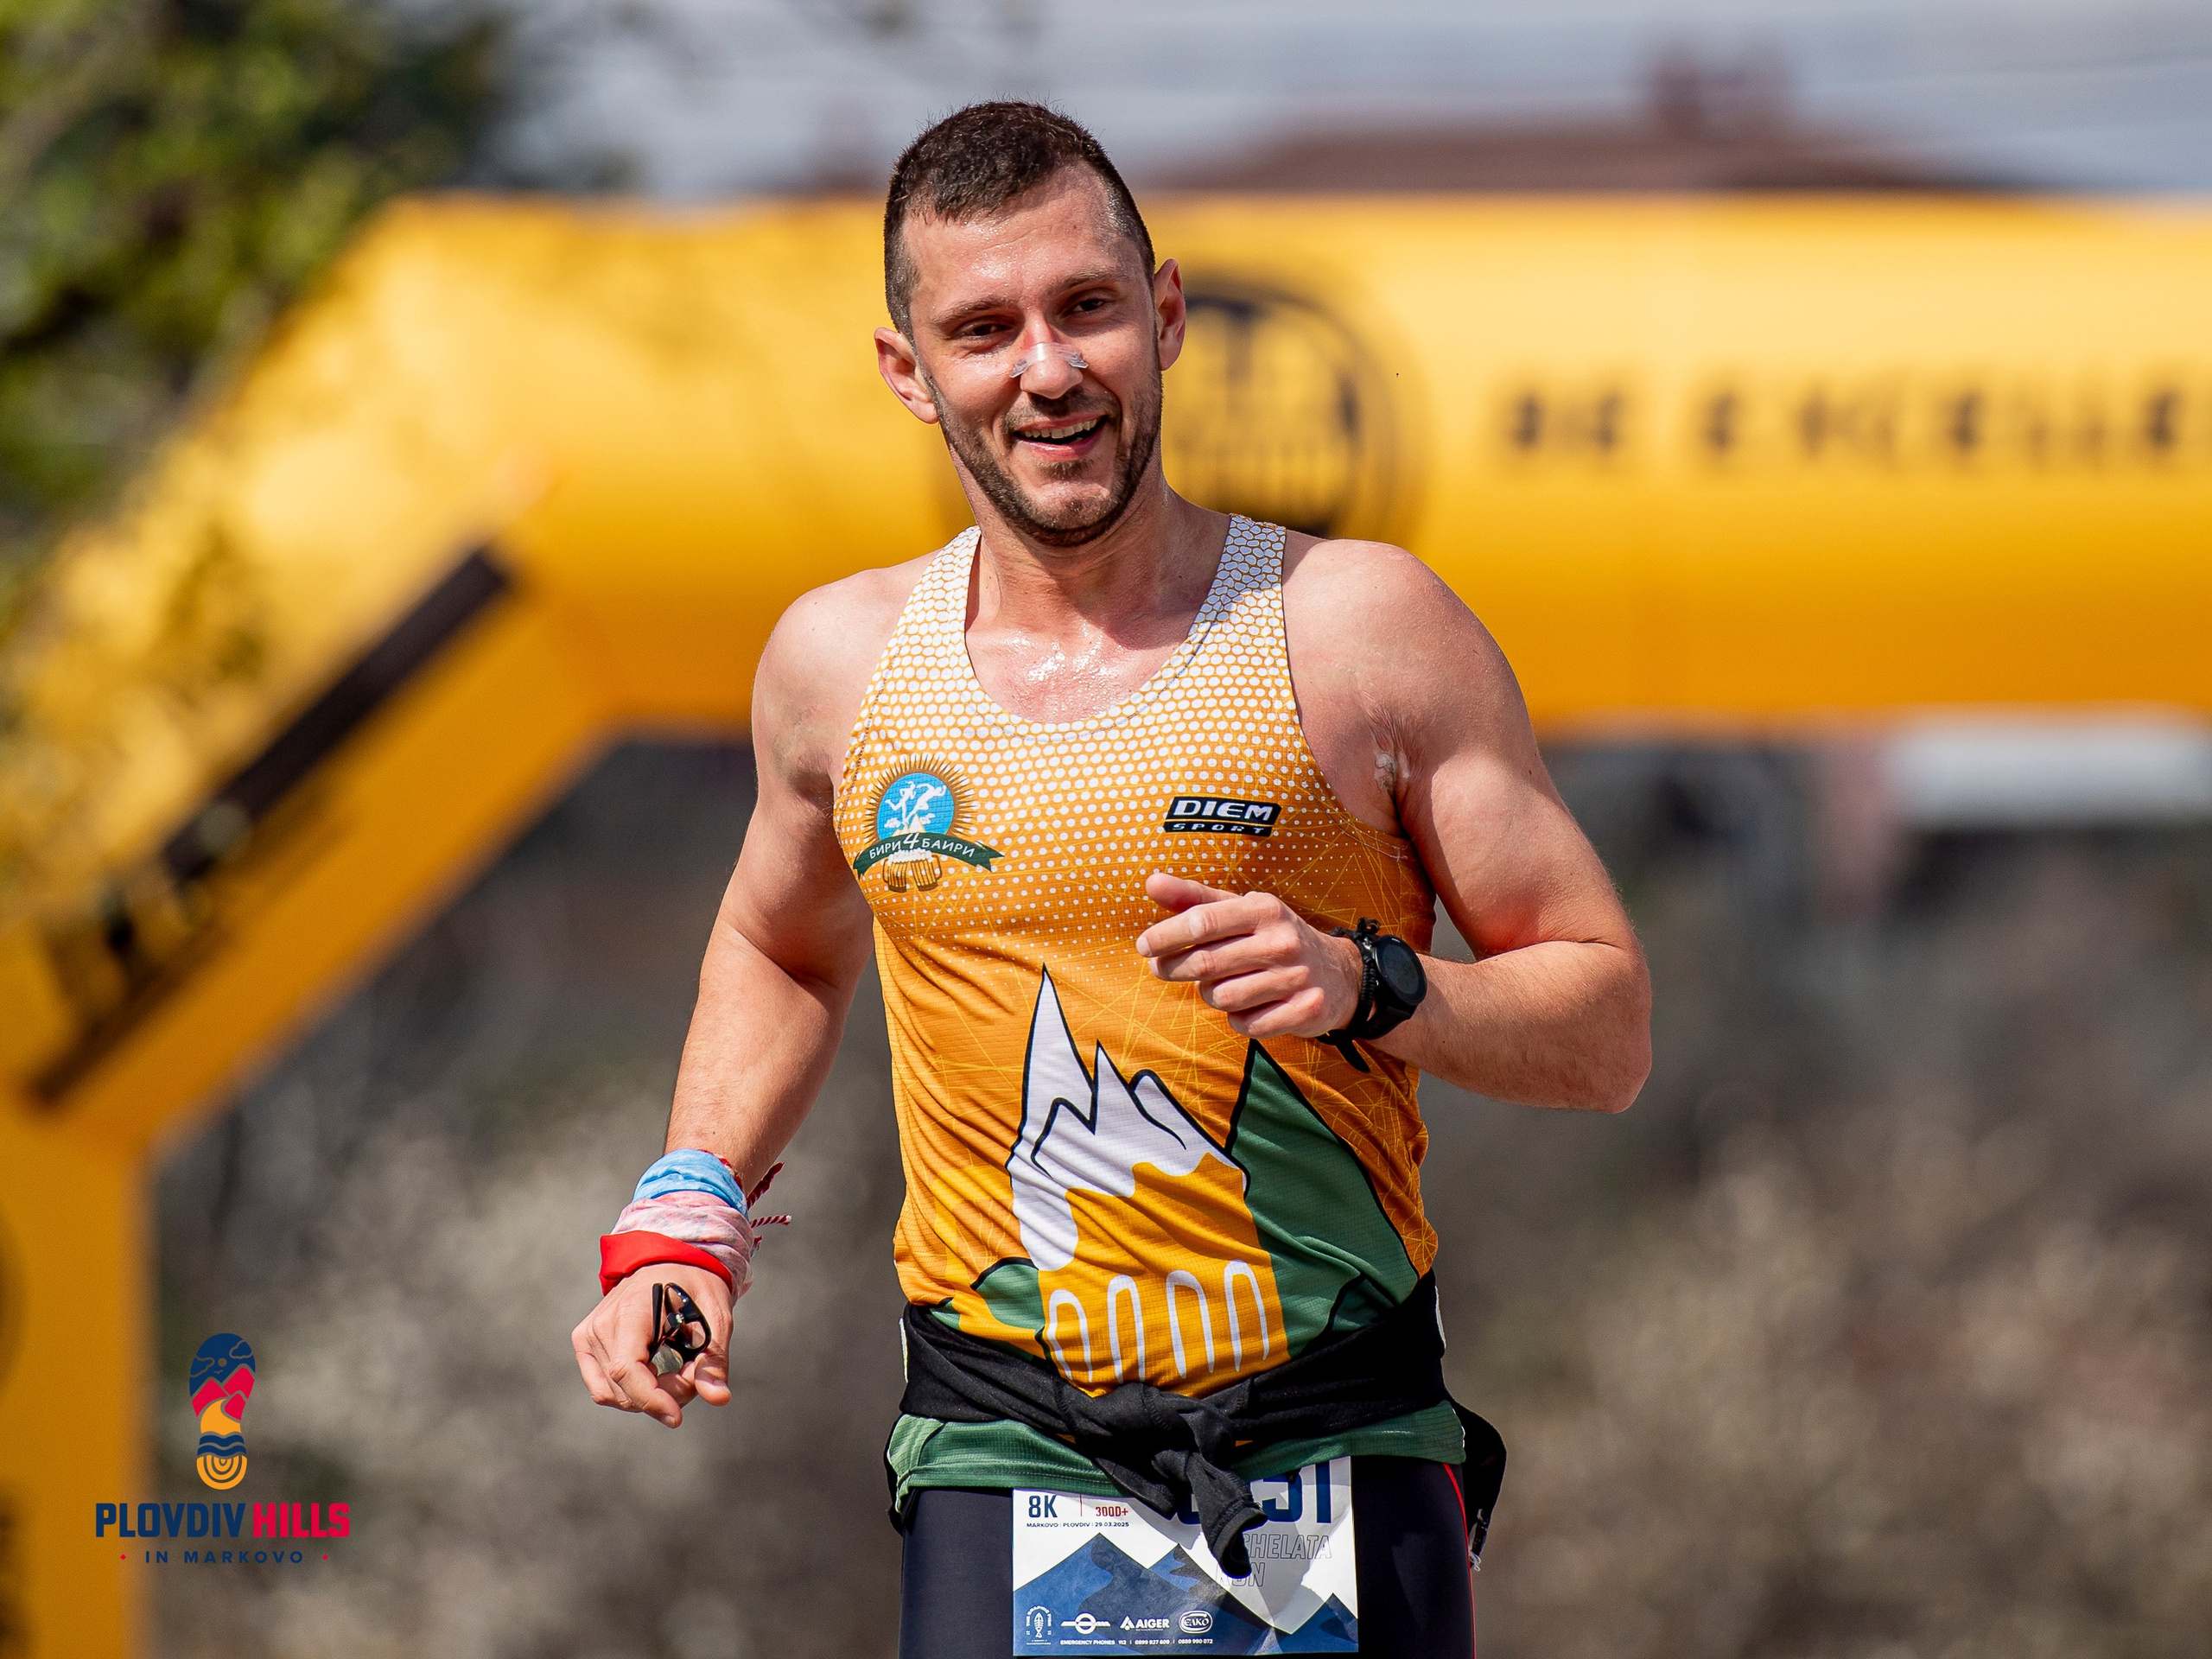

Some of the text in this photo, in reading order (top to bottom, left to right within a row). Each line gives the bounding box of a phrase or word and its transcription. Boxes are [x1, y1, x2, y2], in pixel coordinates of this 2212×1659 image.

[1173, 799, 1274, 821] DIEM
[1172, 823, 1265, 835] SPORT
[869, 832, 976, 859] БИРИ 4 БАИРИ
[1028, 1494, 1058, 1518] 8K
[1135, 1618, 1170, 1629] AIGER
